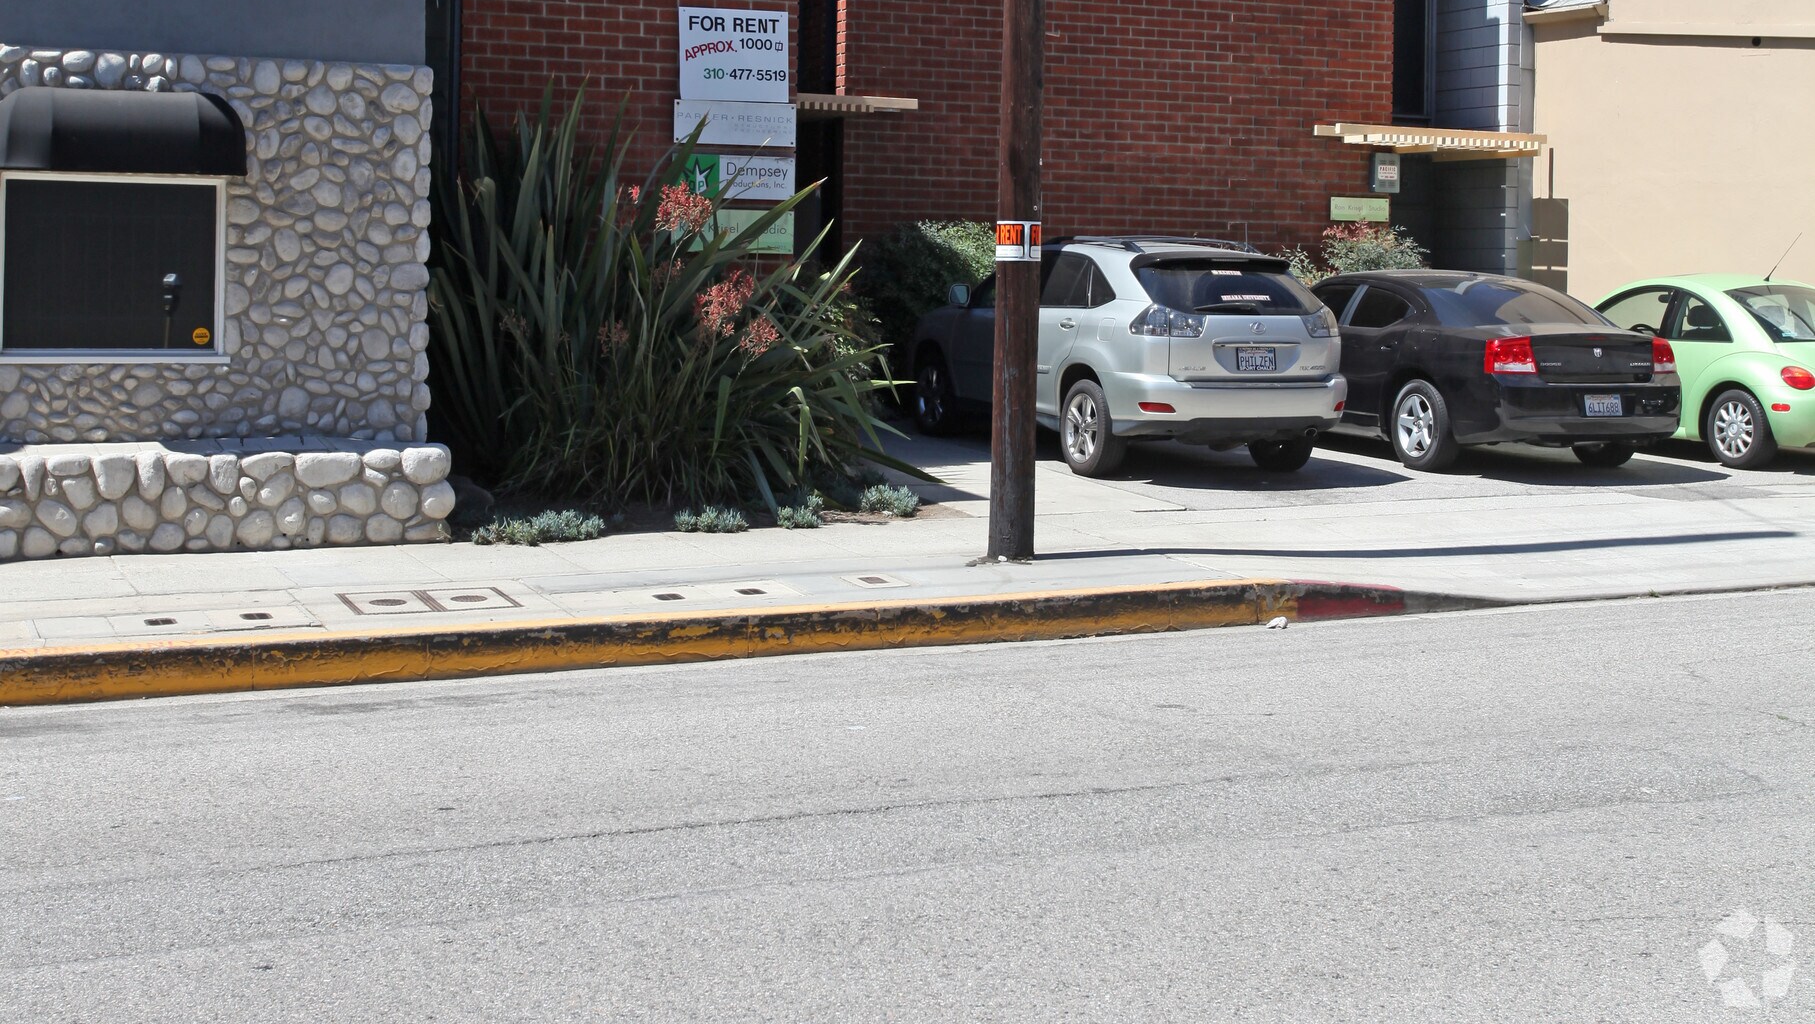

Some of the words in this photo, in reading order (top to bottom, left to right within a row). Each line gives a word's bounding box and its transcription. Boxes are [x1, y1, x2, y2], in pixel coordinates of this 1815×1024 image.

[688, 15, 725, 32] FOR
[733, 17, 780, 34] RENT
[685, 40, 737, 61] APPROX.
[739, 37, 773, 51] 1000
[677, 112, 728, 121] PARER
[726, 161, 789, 181] Dempsey
[1000, 224, 1023, 245] RENT
